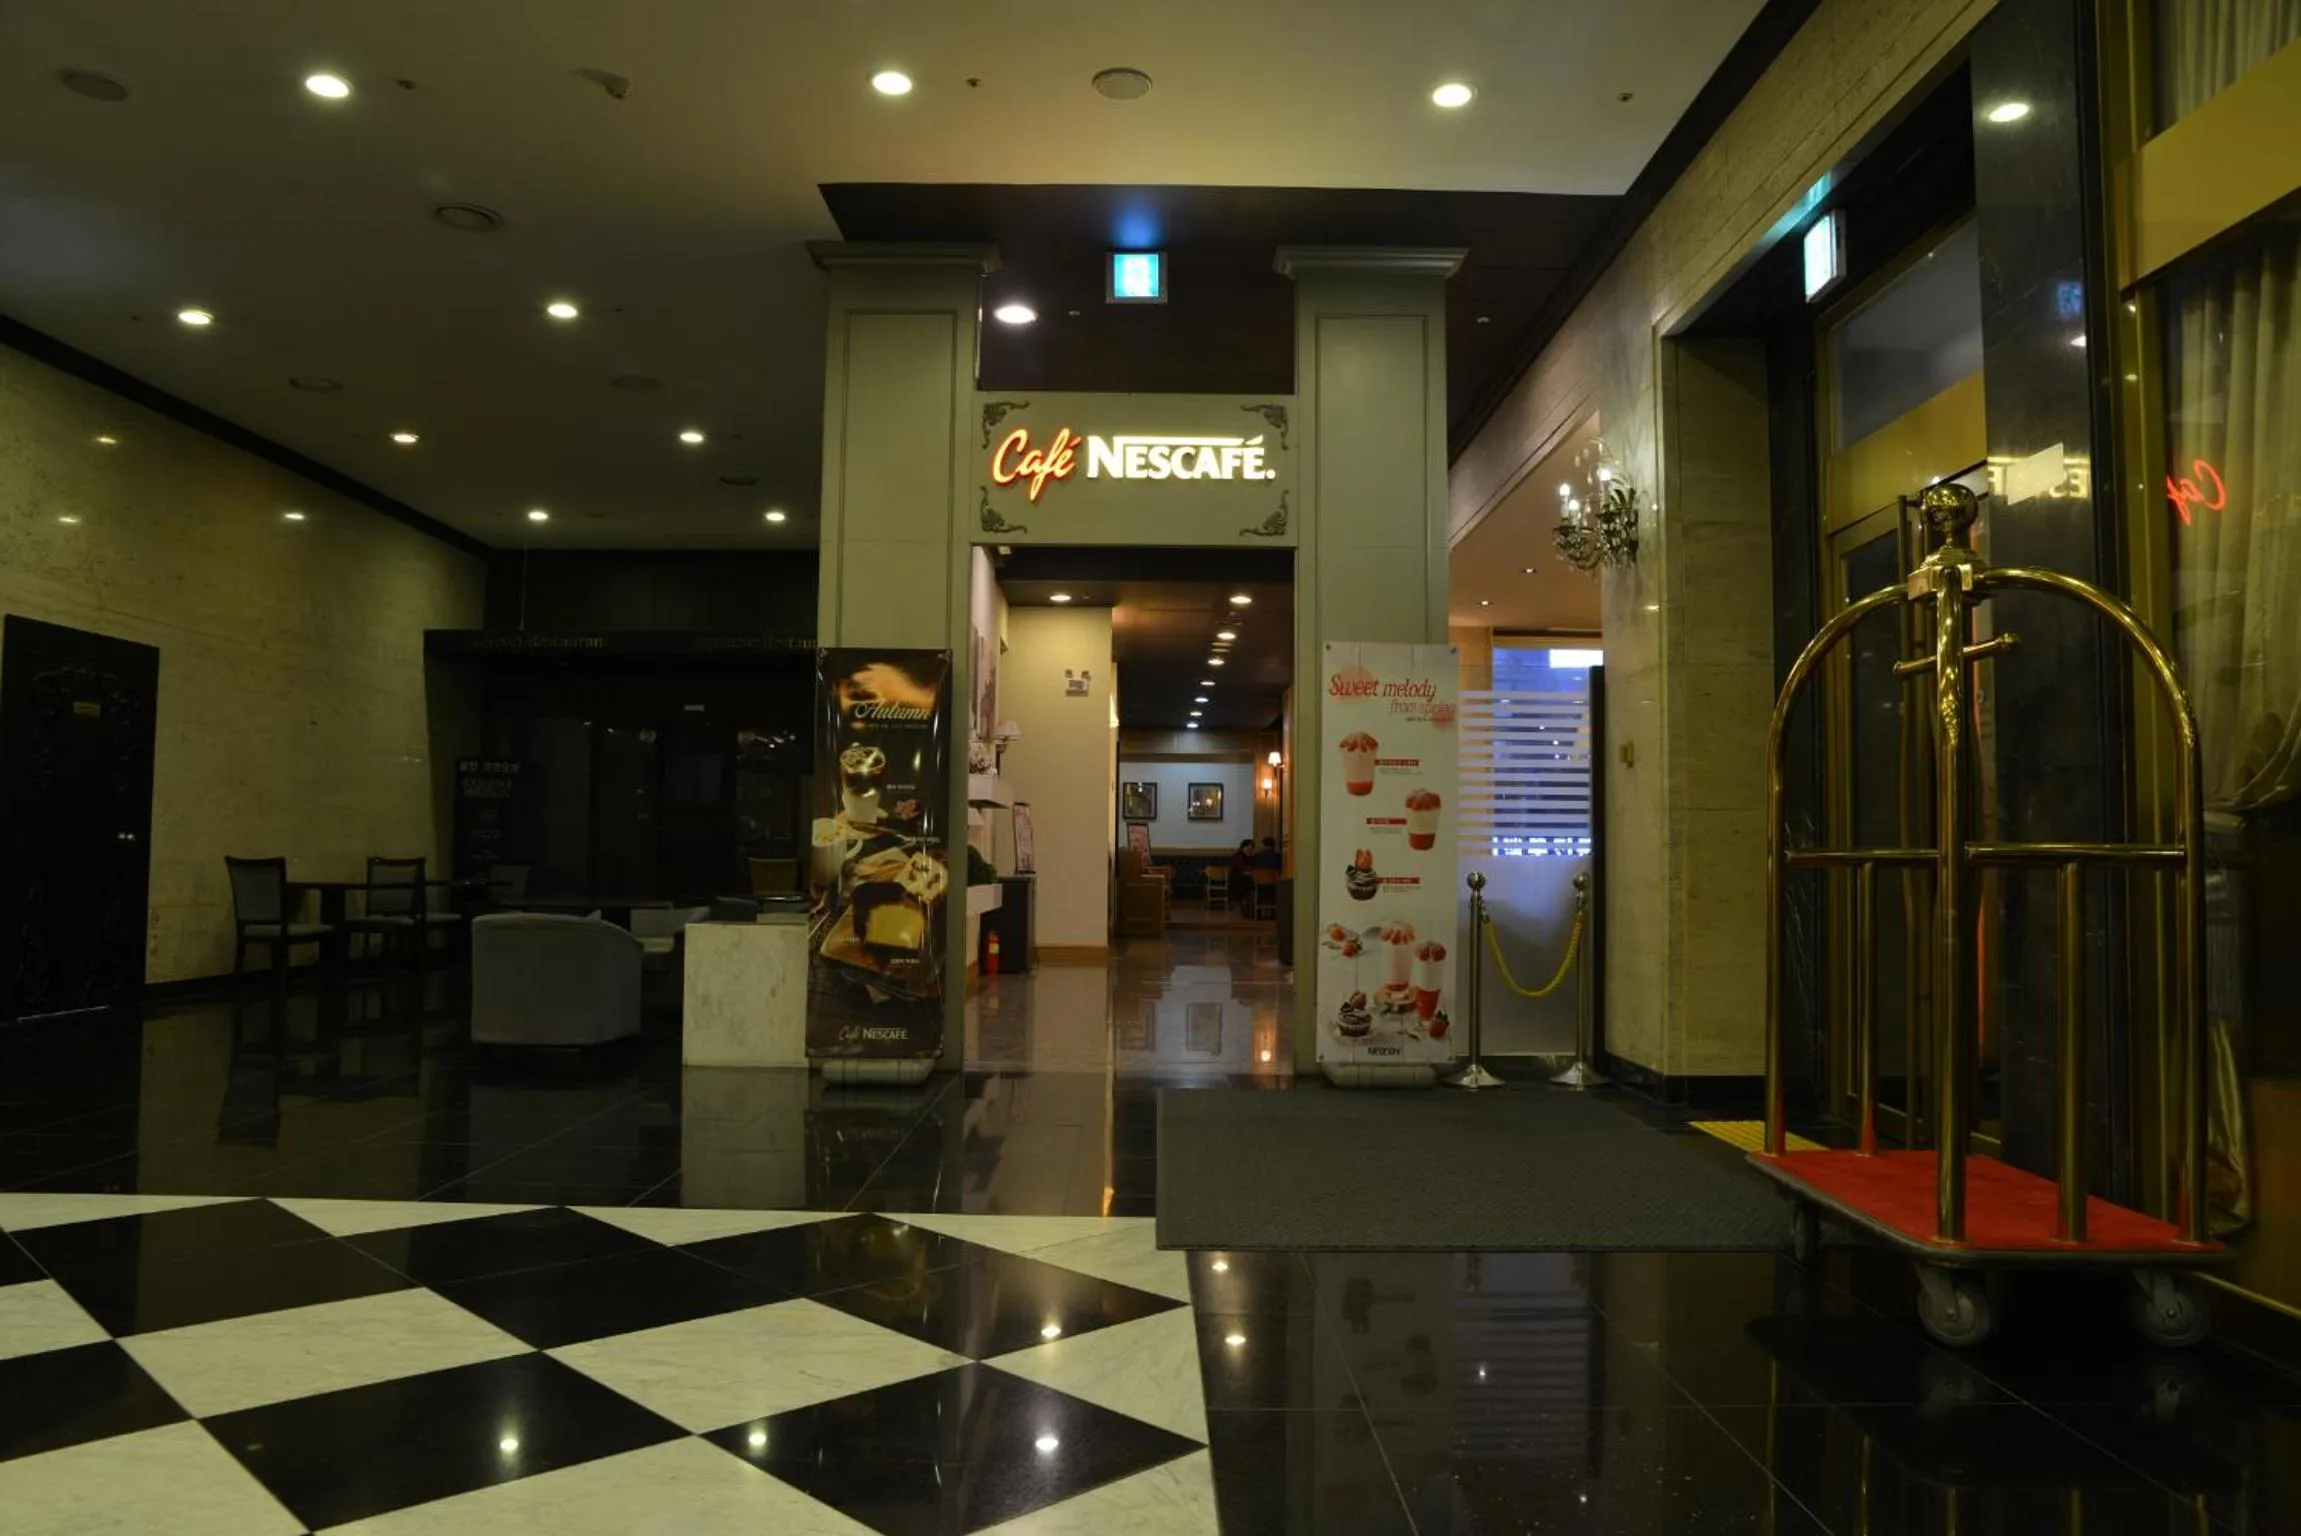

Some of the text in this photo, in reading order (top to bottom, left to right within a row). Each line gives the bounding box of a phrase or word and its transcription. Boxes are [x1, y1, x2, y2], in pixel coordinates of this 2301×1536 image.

[993, 428, 1081, 501] Café
[1329, 672, 1437, 703] Sweet melody
[849, 698, 932, 720] Autumn
